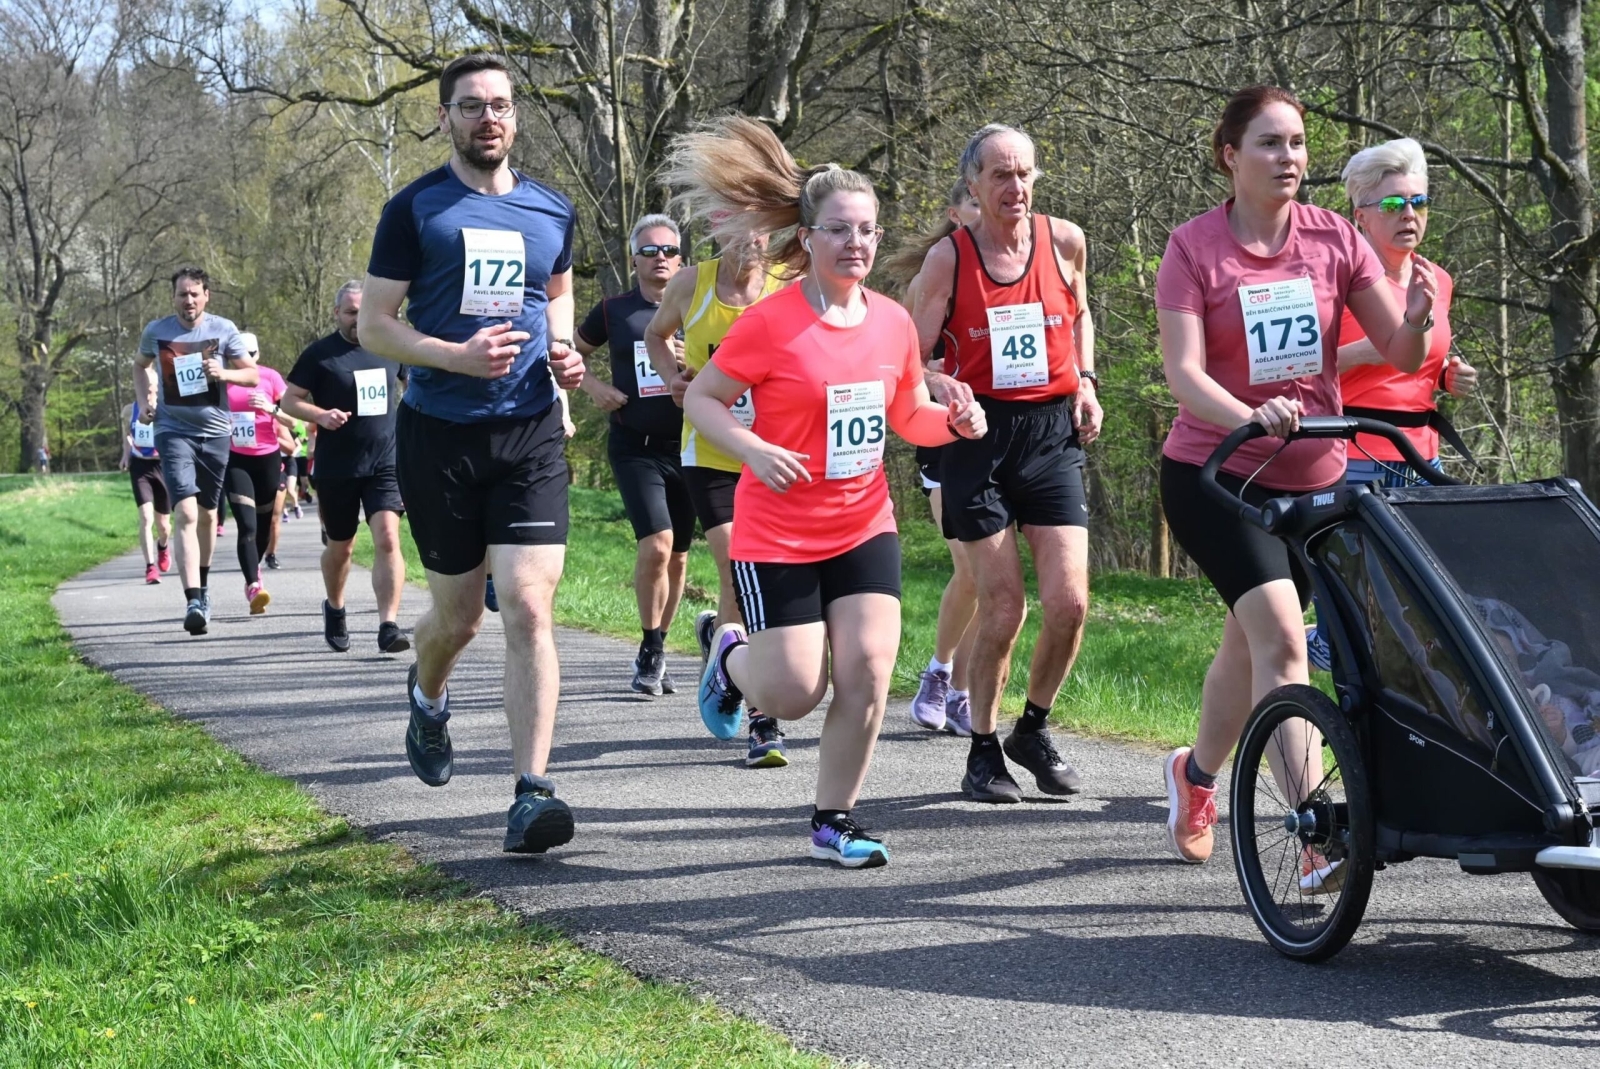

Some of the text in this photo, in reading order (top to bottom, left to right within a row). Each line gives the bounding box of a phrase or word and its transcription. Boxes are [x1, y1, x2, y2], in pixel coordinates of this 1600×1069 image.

[468, 259, 523, 287] 172
[1249, 294, 1271, 304] CUP
[995, 314, 1012, 323] CUP
[1249, 314, 1319, 353] 173
[1002, 333, 1037, 361] 48
[1254, 348, 1317, 364] ADÉLA BURDYCHOVÁ
[178, 367, 205, 382] 102
[360, 385, 386, 400] 104
[834, 394, 852, 403] CUP
[138, 430, 150, 438] 81
[232, 426, 255, 438] 416
[830, 415, 884, 448] 103
[832, 449, 857, 457] BARBORA
[1312, 492, 1335, 507] THULE
[1409, 733, 1425, 747] SPORT
